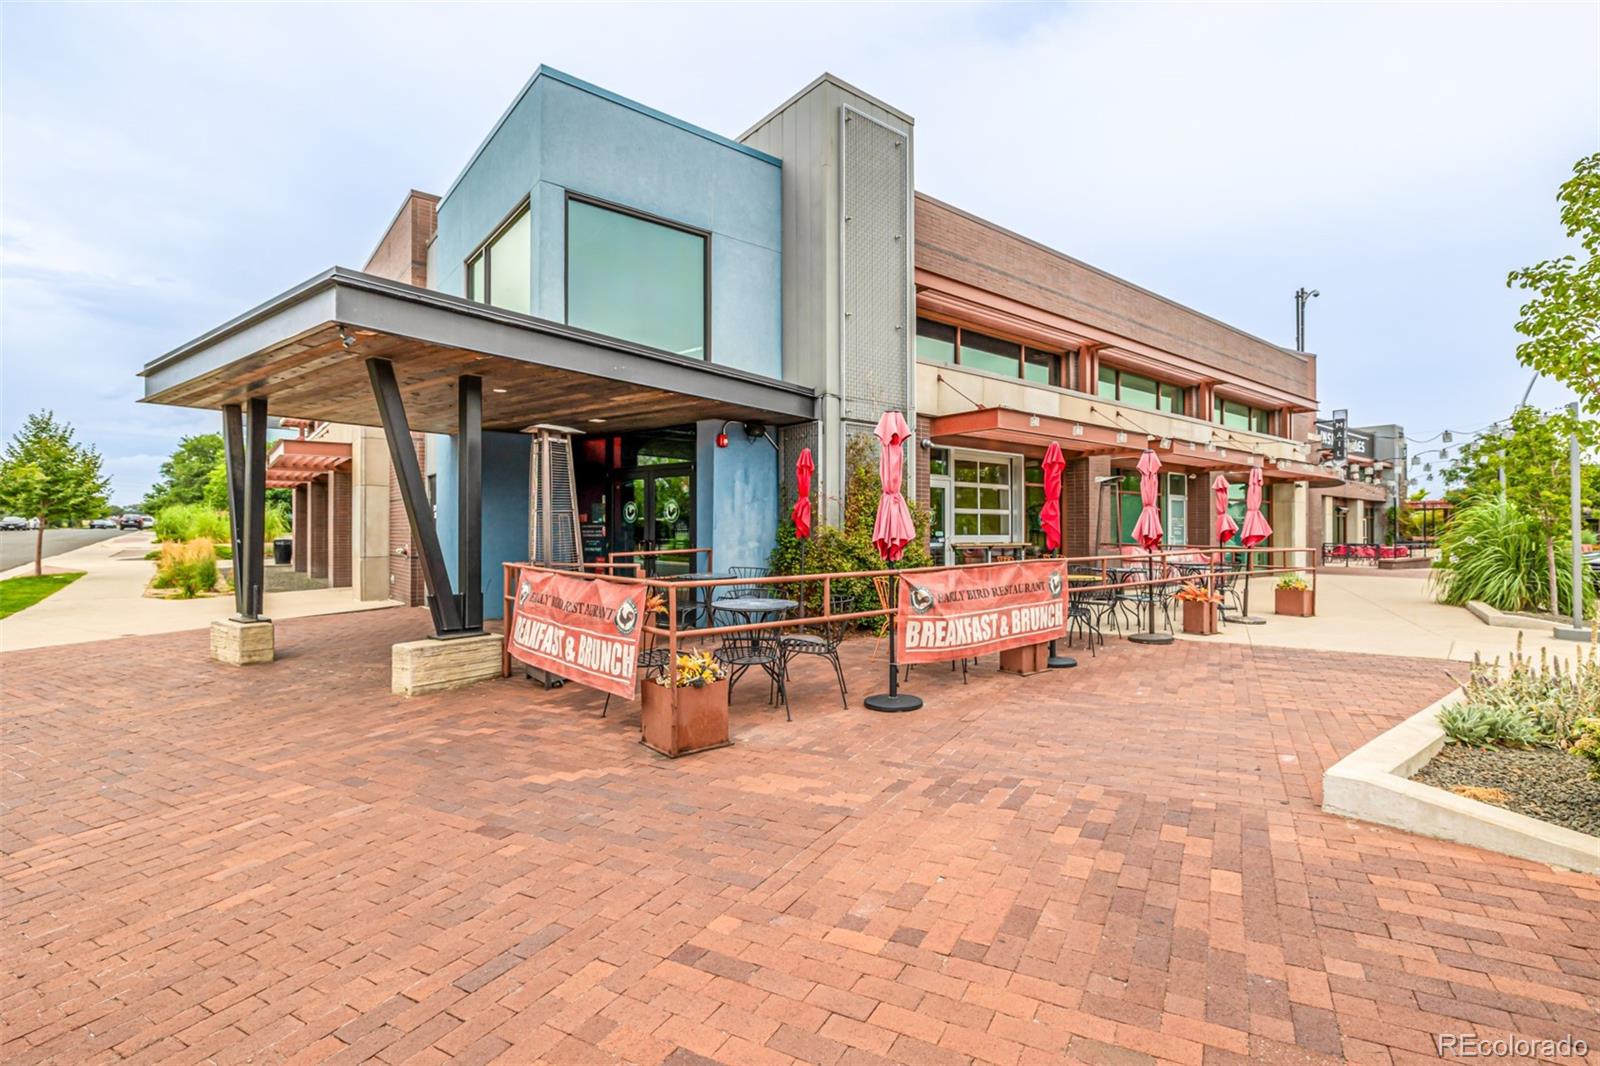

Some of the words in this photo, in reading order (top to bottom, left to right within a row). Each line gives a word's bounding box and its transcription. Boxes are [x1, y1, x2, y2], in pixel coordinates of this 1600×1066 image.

[529, 591, 551, 606] EALY
[562, 601, 615, 620] RSTAURANT
[937, 590, 967, 604] EARLY
[967, 588, 990, 601] BIRD
[992, 581, 1045, 598] RESTAURANT
[905, 613, 998, 648] BREAKFAST
[1000, 615, 1009, 636] &
[1011, 602, 1064, 631] BRUNCH
[565, 636, 576, 662] &
[577, 634, 636, 678] BRUNCH
